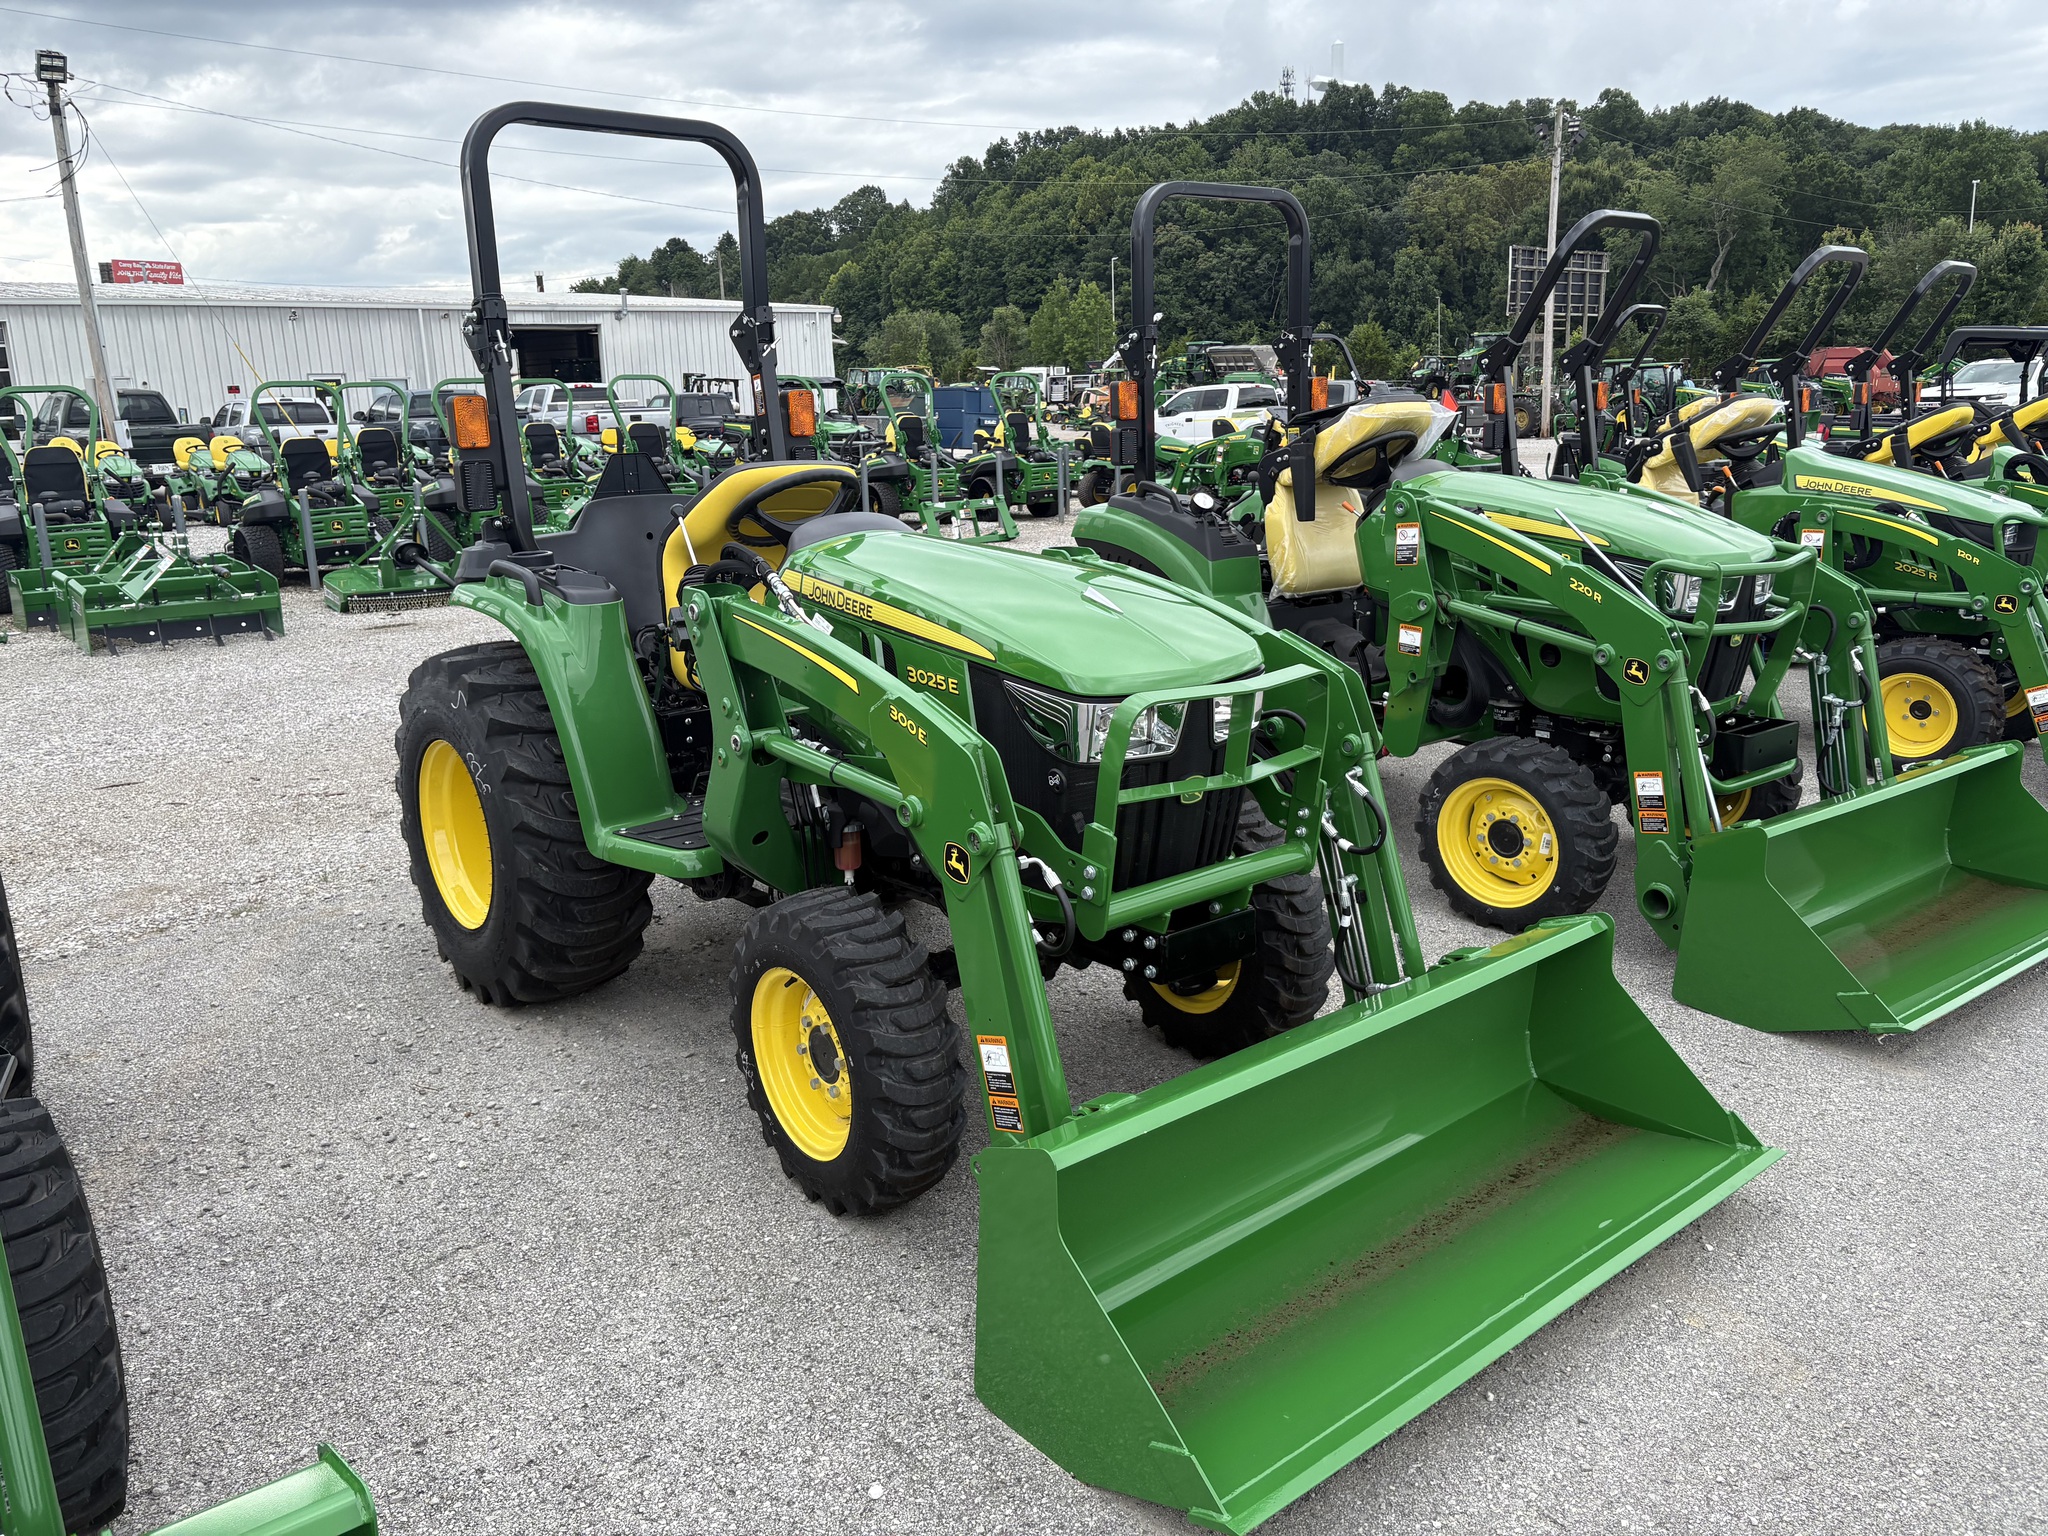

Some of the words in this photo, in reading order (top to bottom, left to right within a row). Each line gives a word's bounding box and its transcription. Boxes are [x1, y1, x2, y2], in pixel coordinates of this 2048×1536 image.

[1803, 479, 1832, 491] JOHN
[1834, 482, 1873, 496] DEERE
[1894, 561, 1926, 577] 2025
[808, 582, 836, 606] JOHN
[836, 590, 873, 619] DEERE
[997, 1099, 1016, 1107] WARNING
